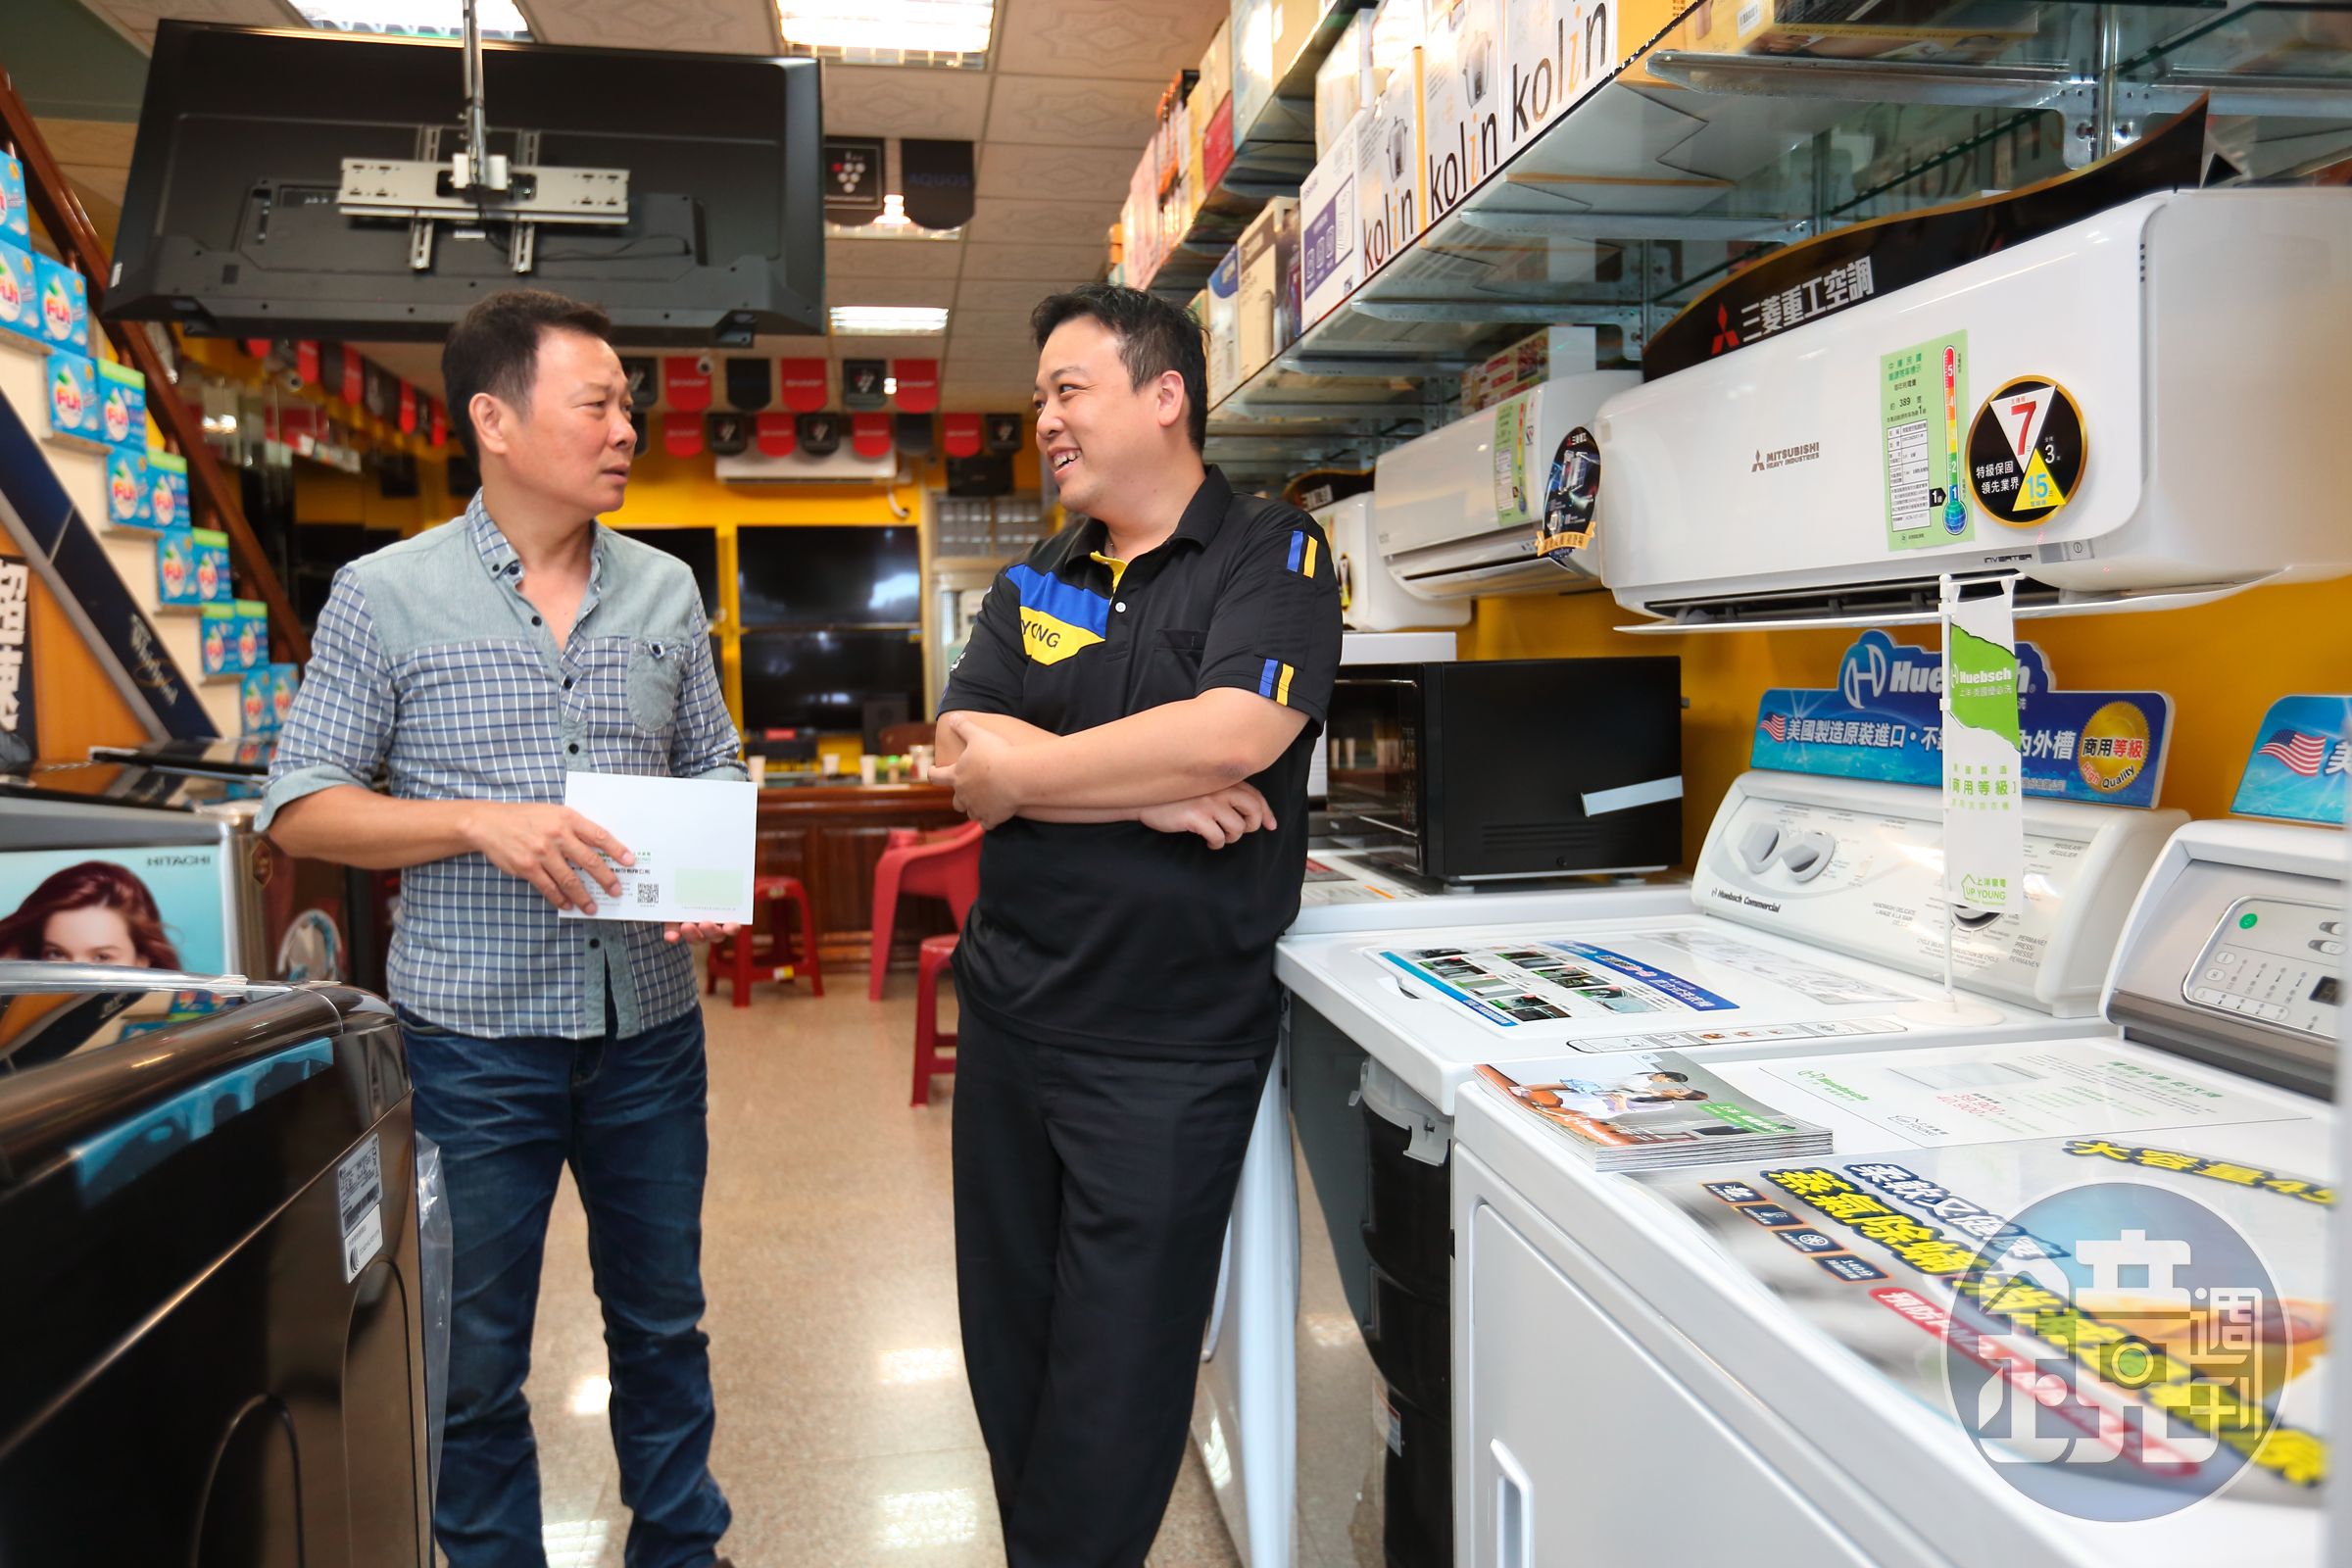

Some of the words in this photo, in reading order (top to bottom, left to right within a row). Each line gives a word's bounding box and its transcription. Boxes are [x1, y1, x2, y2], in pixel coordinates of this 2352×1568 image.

[1512, 2, 1607, 142] kolin
[1429, 112, 1497, 221] kolin
[1363, 186, 1413, 277] kolin
[1740, 256, 1875, 343] 三菱重工空調
[2010, 400, 2037, 457] 7
[1766, 442, 1820, 463] MITSUBISHI
[2044, 444, 2055, 465] 3
[1976, 461, 2015, 479] 特級保固
[1982, 476, 2021, 495] 領先業界
[2025, 473, 2049, 499] 15
[1984, 553, 2033, 564] INVERTER
[1959, 667, 2012, 685] Huebsch
[2082, 737, 2144, 760] 商用等級
[2082, 760, 2100, 785] High
[2101, 764, 2135, 789] Quality
[147, 856, 211, 866] HITACHI
[1966, 886, 1976, 897] UP
[1977, 889, 2007, 901] YOUNG
[1743, 896, 1782, 913] Commercial
